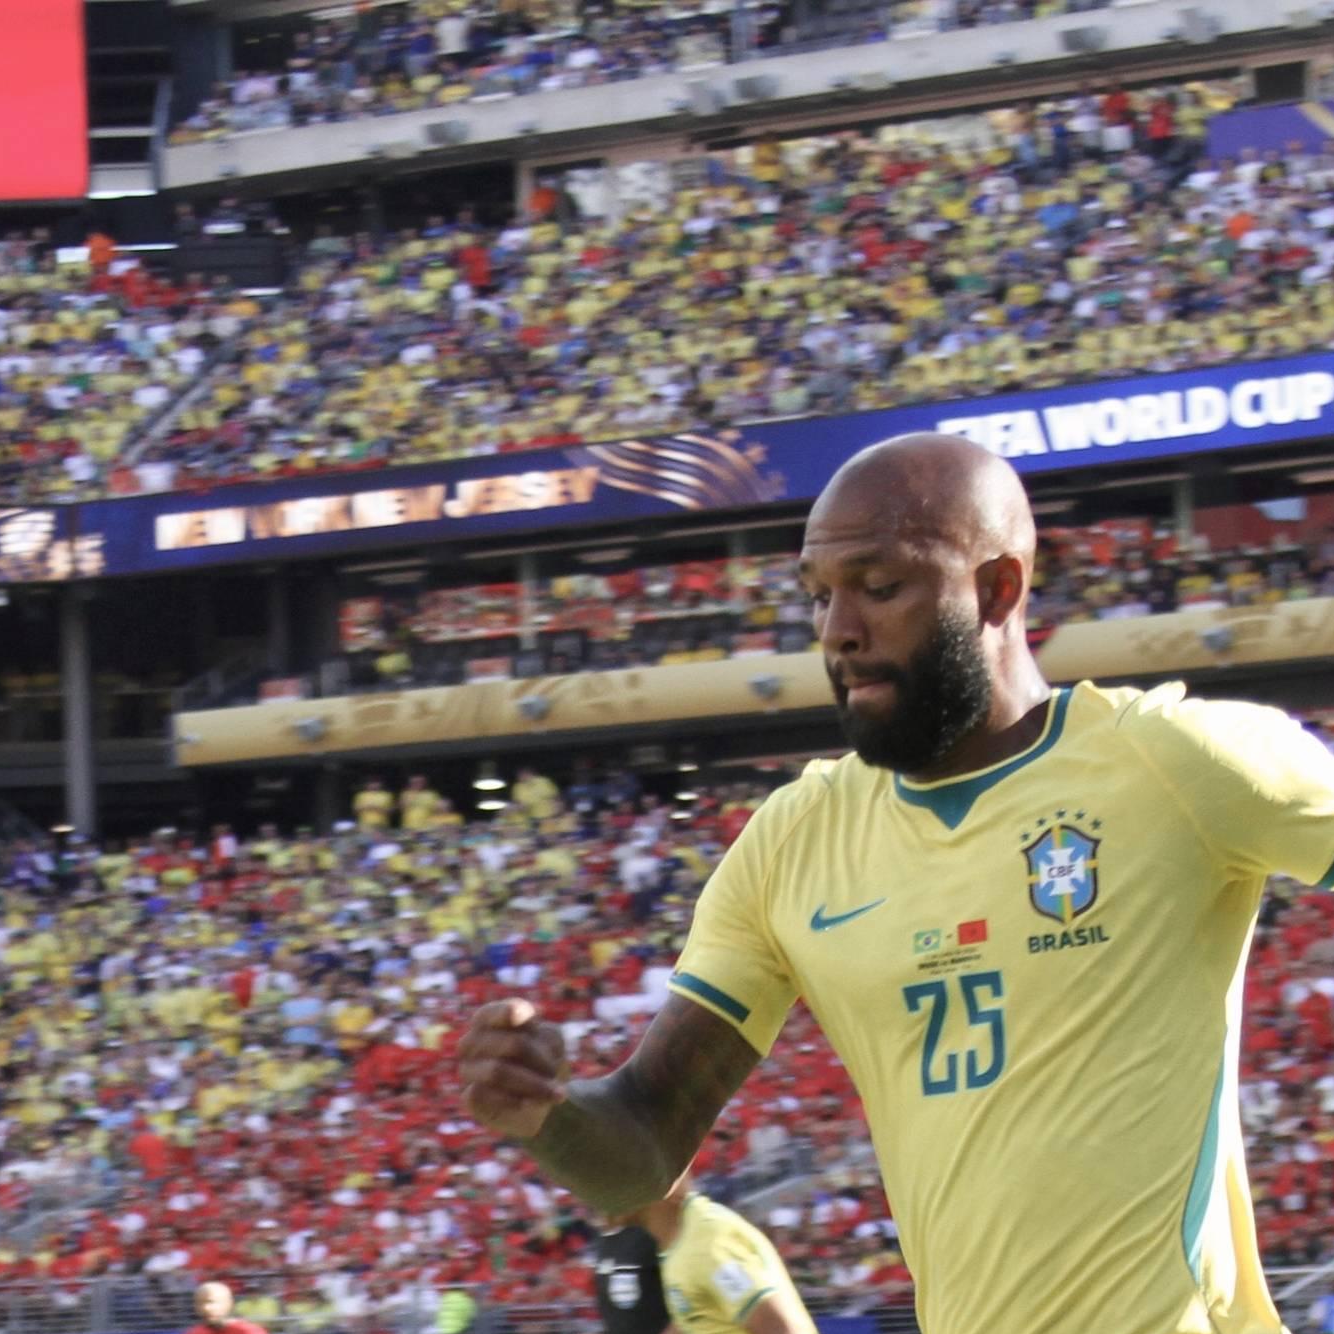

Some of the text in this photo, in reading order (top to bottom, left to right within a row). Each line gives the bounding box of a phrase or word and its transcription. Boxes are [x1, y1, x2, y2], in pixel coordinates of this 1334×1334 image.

[1042, 387, 1229, 452] WORLD
[444, 466, 599, 518] JERSEY
[1047, 864, 1076, 879] CBF
[1028, 926, 1110, 954] BRASIL
[902, 969, 1006, 1097] 25
